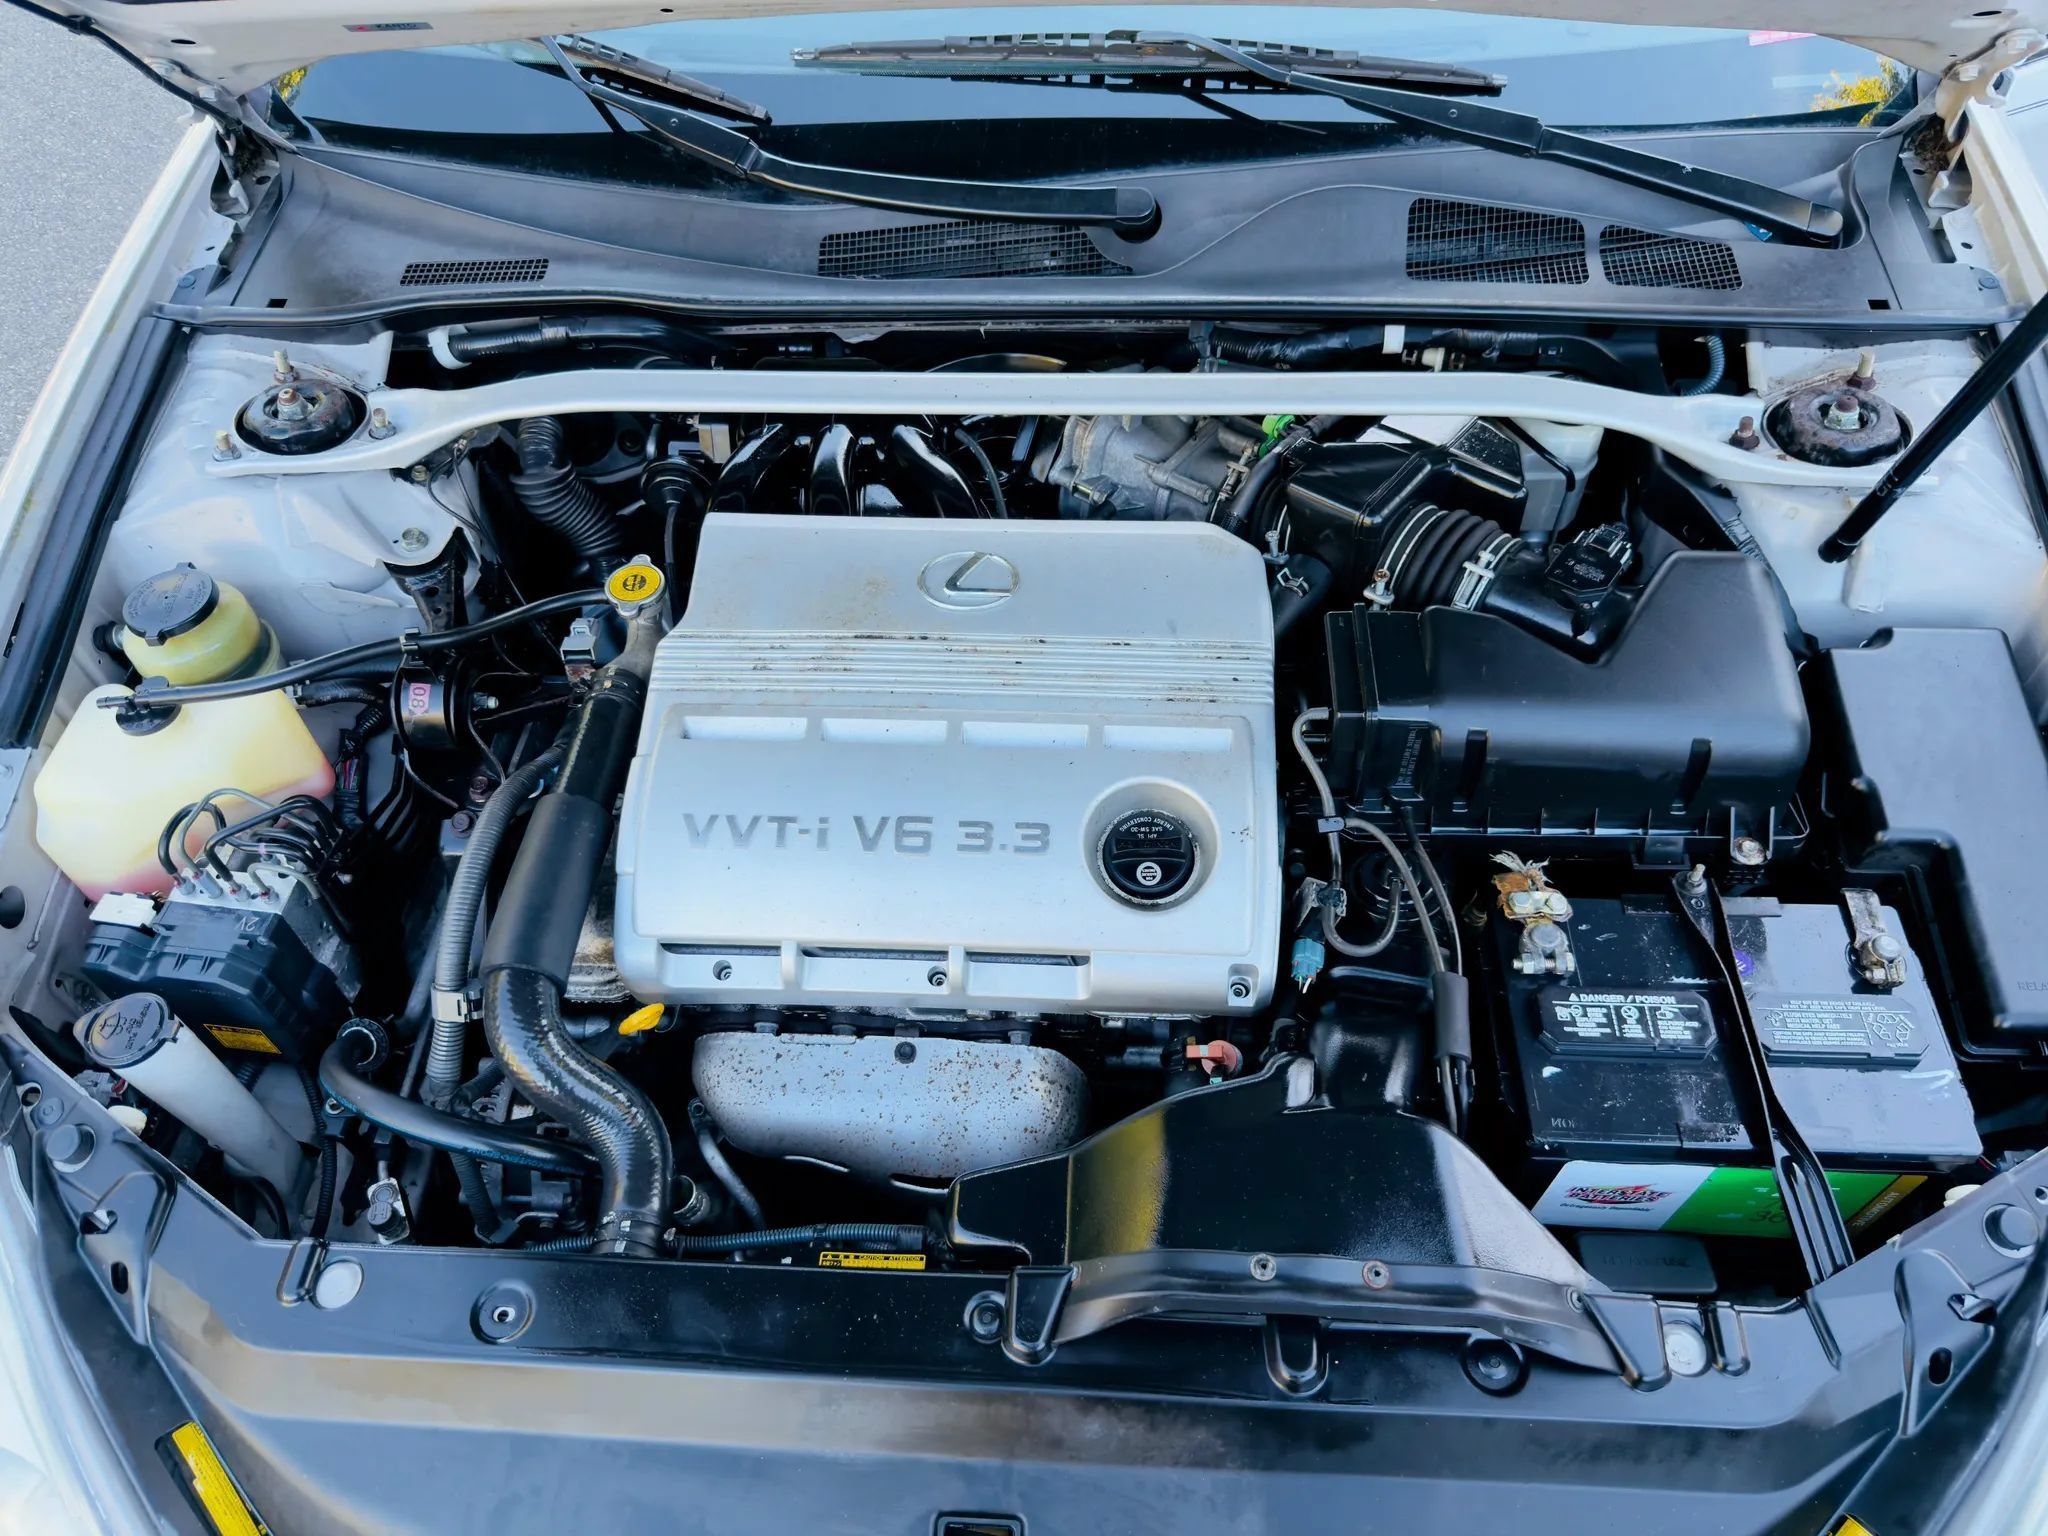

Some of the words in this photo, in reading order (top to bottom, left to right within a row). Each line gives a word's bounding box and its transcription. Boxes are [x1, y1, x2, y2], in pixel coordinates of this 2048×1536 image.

[1119, 816, 1152, 832] CONSERVING
[1152, 817, 1175, 831] ENERGY
[682, 813, 830, 849] VVT-i
[852, 815, 935, 853] V6
[956, 820, 1051, 853] 3.3
[1579, 993, 1625, 1003] DANGER
[1635, 995, 1676, 1004] POISON
[1566, 1192, 1661, 1202] BATTERIES
[1568, 1186, 1672, 1197] INTERSTATE
